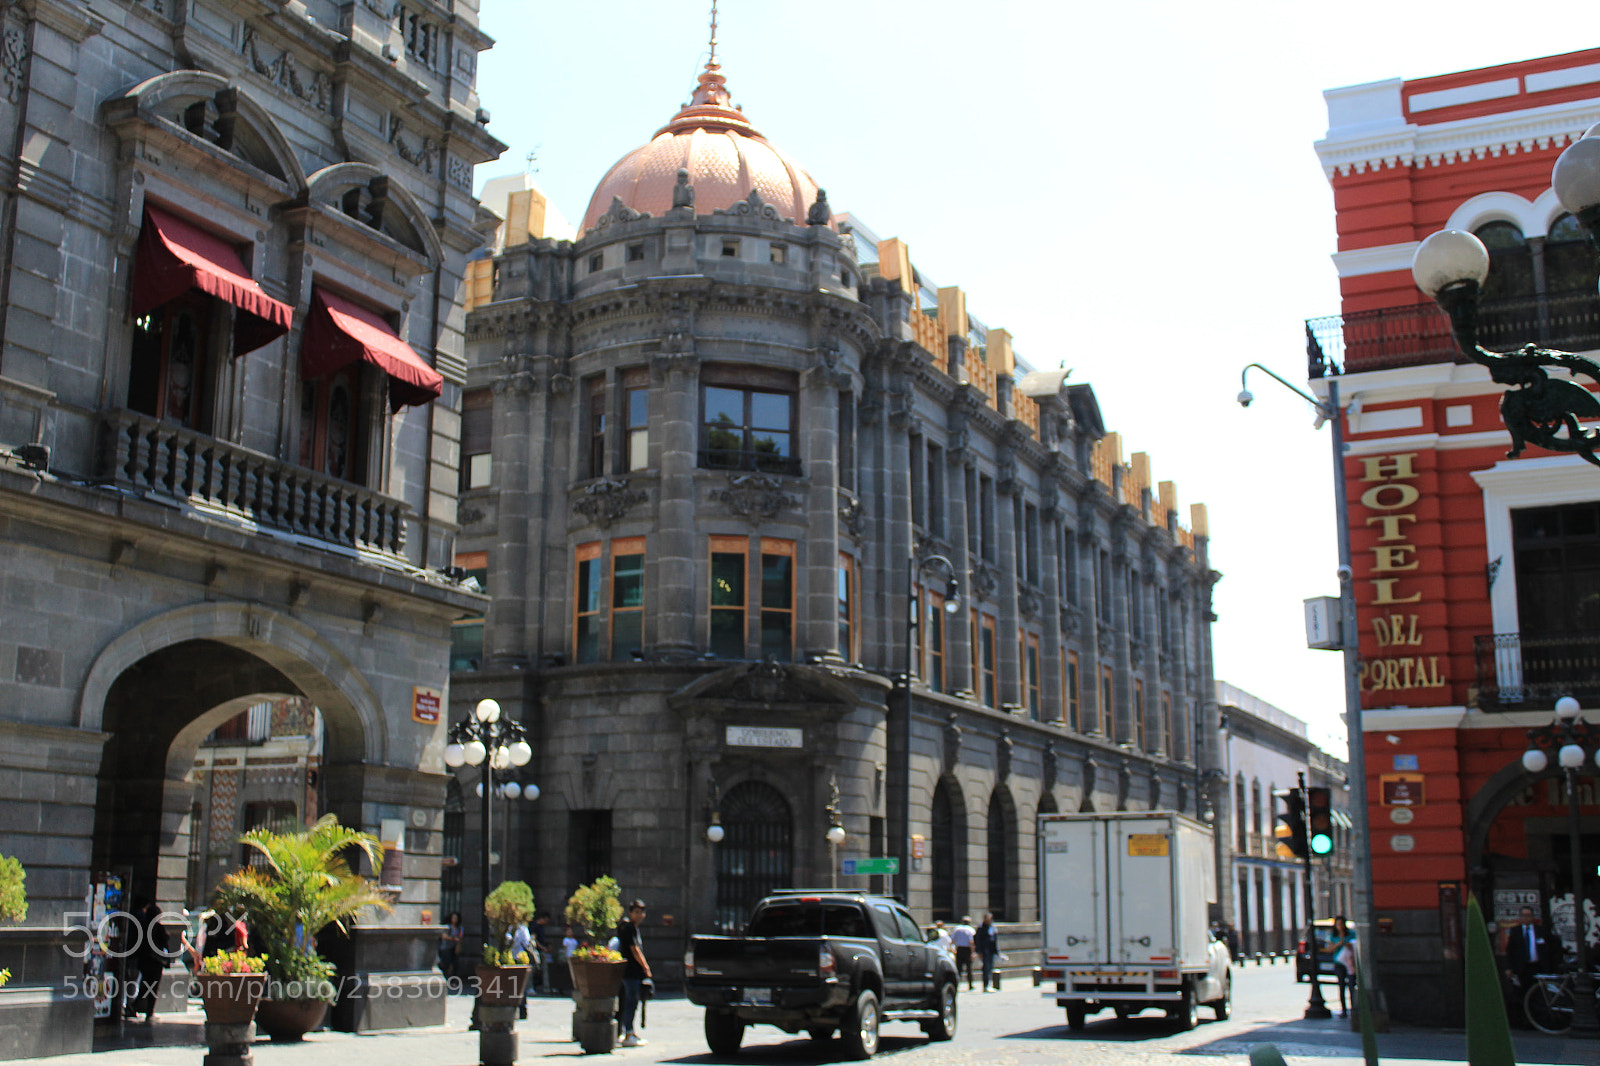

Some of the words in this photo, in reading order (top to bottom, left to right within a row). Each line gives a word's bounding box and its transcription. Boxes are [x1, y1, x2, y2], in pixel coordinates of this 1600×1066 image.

[1358, 453, 1421, 605] HOTEL
[1372, 615, 1422, 646] DEL
[1360, 656, 1445, 691] PORTAL
